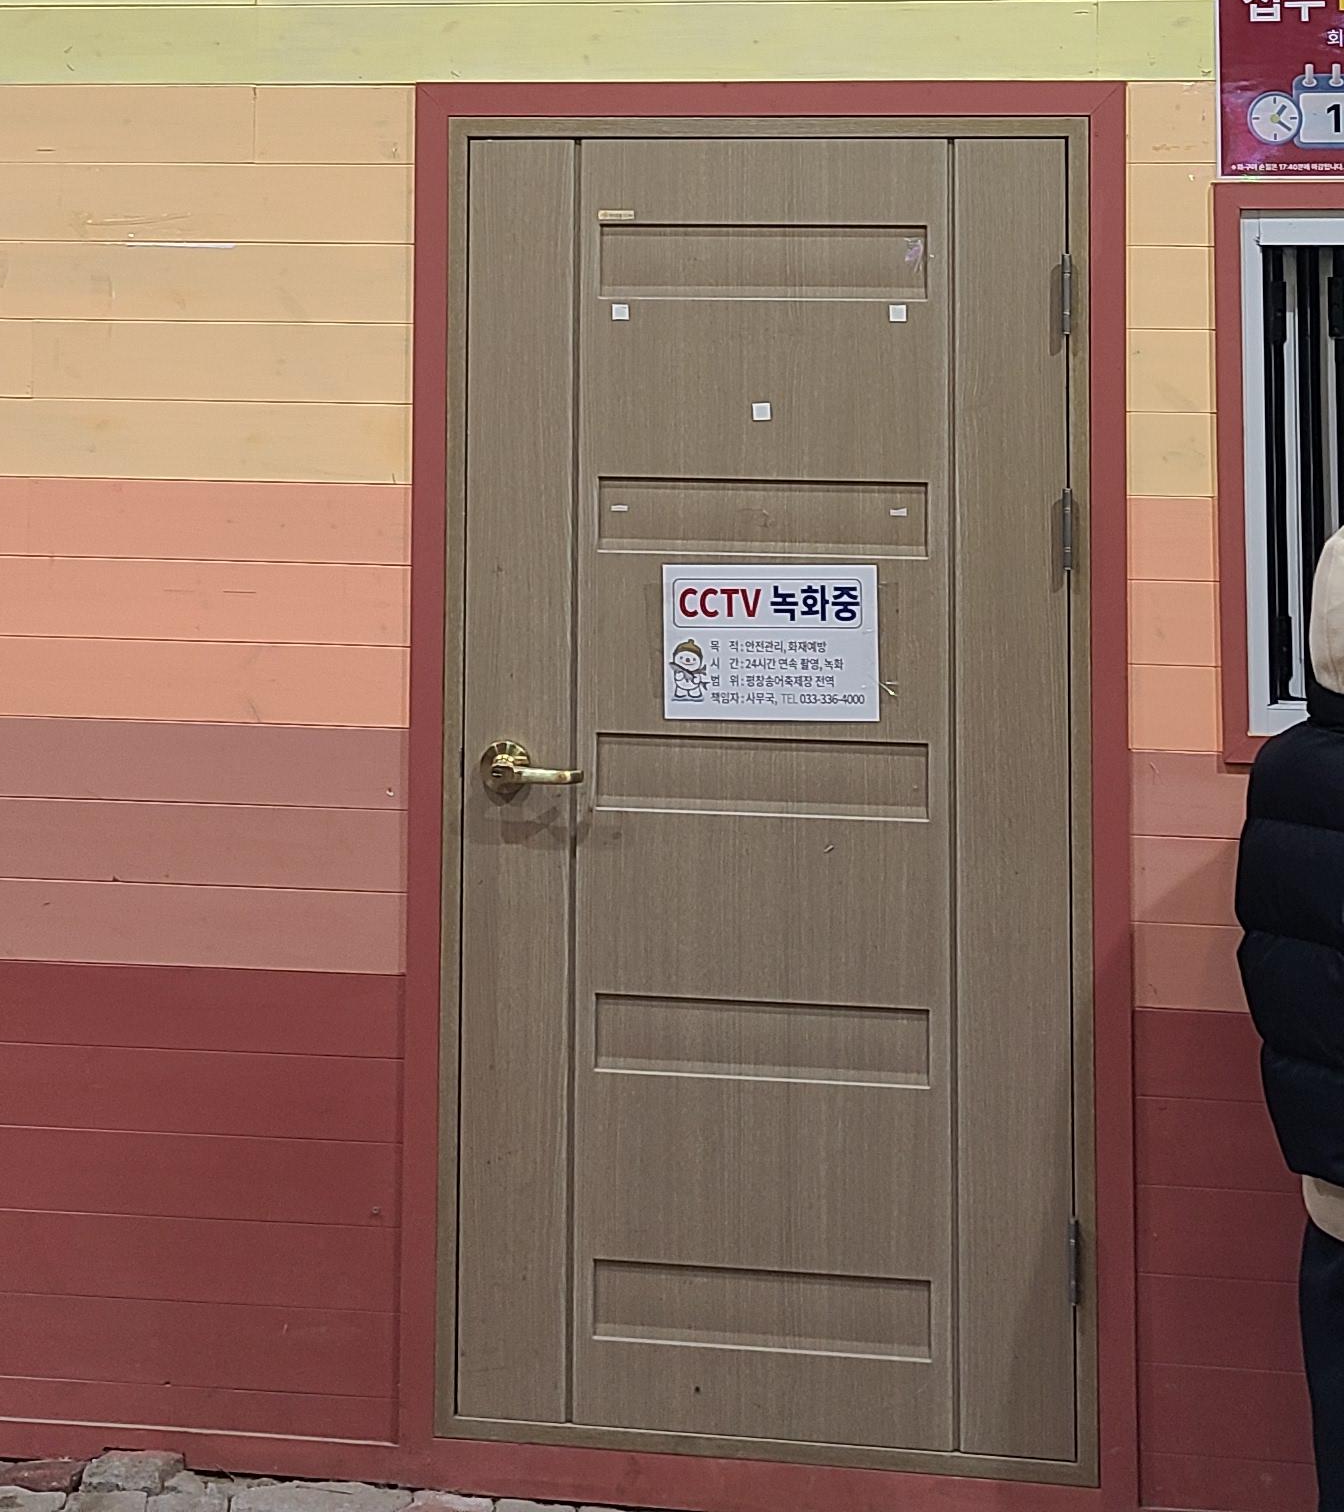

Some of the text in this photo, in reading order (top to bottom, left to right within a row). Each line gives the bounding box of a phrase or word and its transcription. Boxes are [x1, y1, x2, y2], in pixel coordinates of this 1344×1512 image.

[678, 584, 861, 623] CCTV 녹화중
[710, 640, 720, 653] 목
[787, 640, 827, 653] 화재예방
[710, 657, 720, 670] 시
[745, 658, 776, 670] 24시간
[778, 658, 798, 671] 연속
[824, 658, 844, 671] 녹화
[815, 675, 835, 688] 전역
[782, 694, 798, 705] TEL
